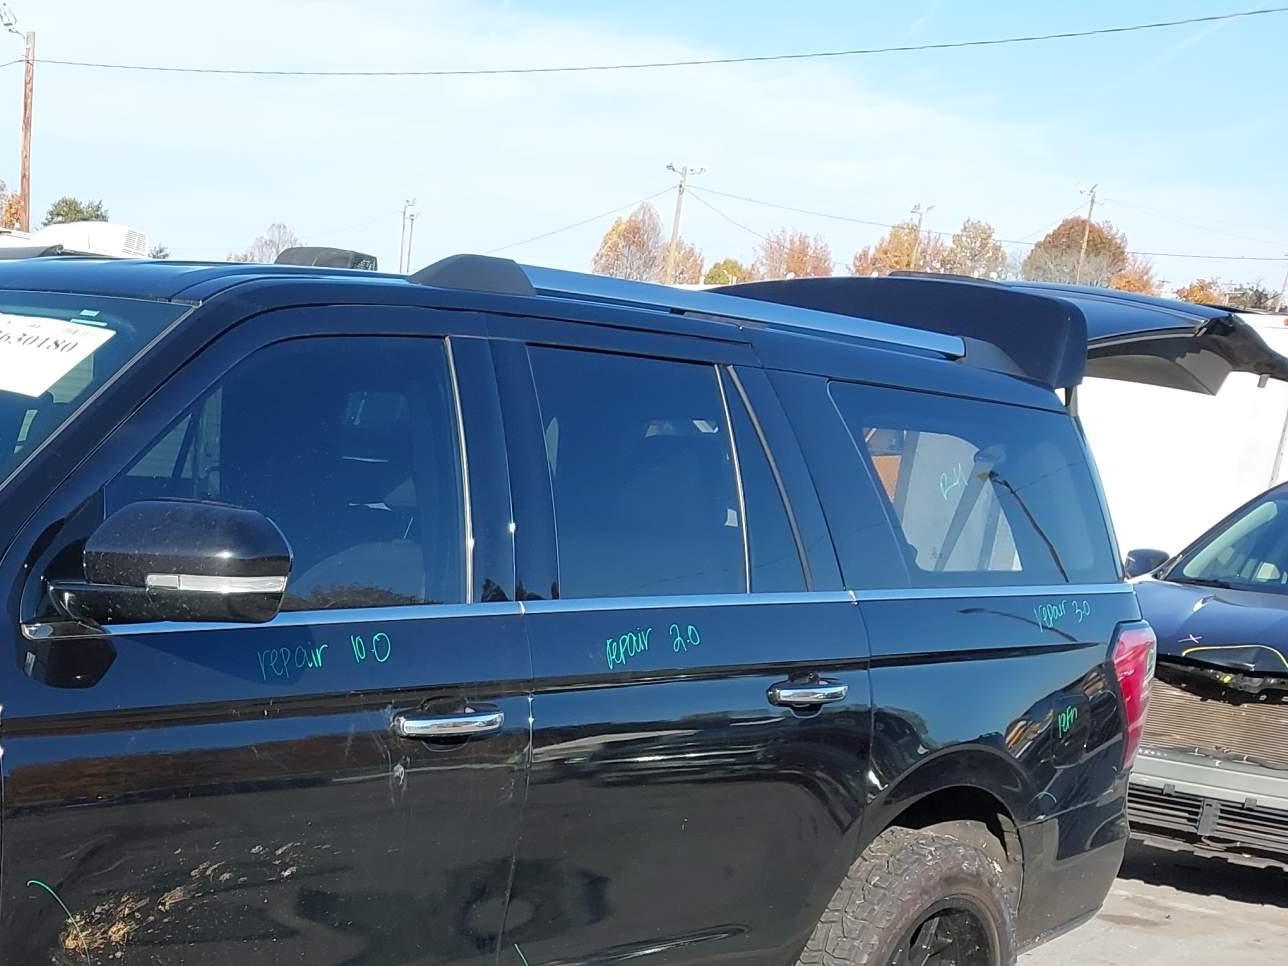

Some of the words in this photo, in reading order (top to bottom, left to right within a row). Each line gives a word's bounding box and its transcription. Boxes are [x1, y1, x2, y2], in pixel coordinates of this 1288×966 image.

[1033, 599, 1067, 633] repair
[256, 641, 329, 682] repair
[605, 626, 653, 671] repair
